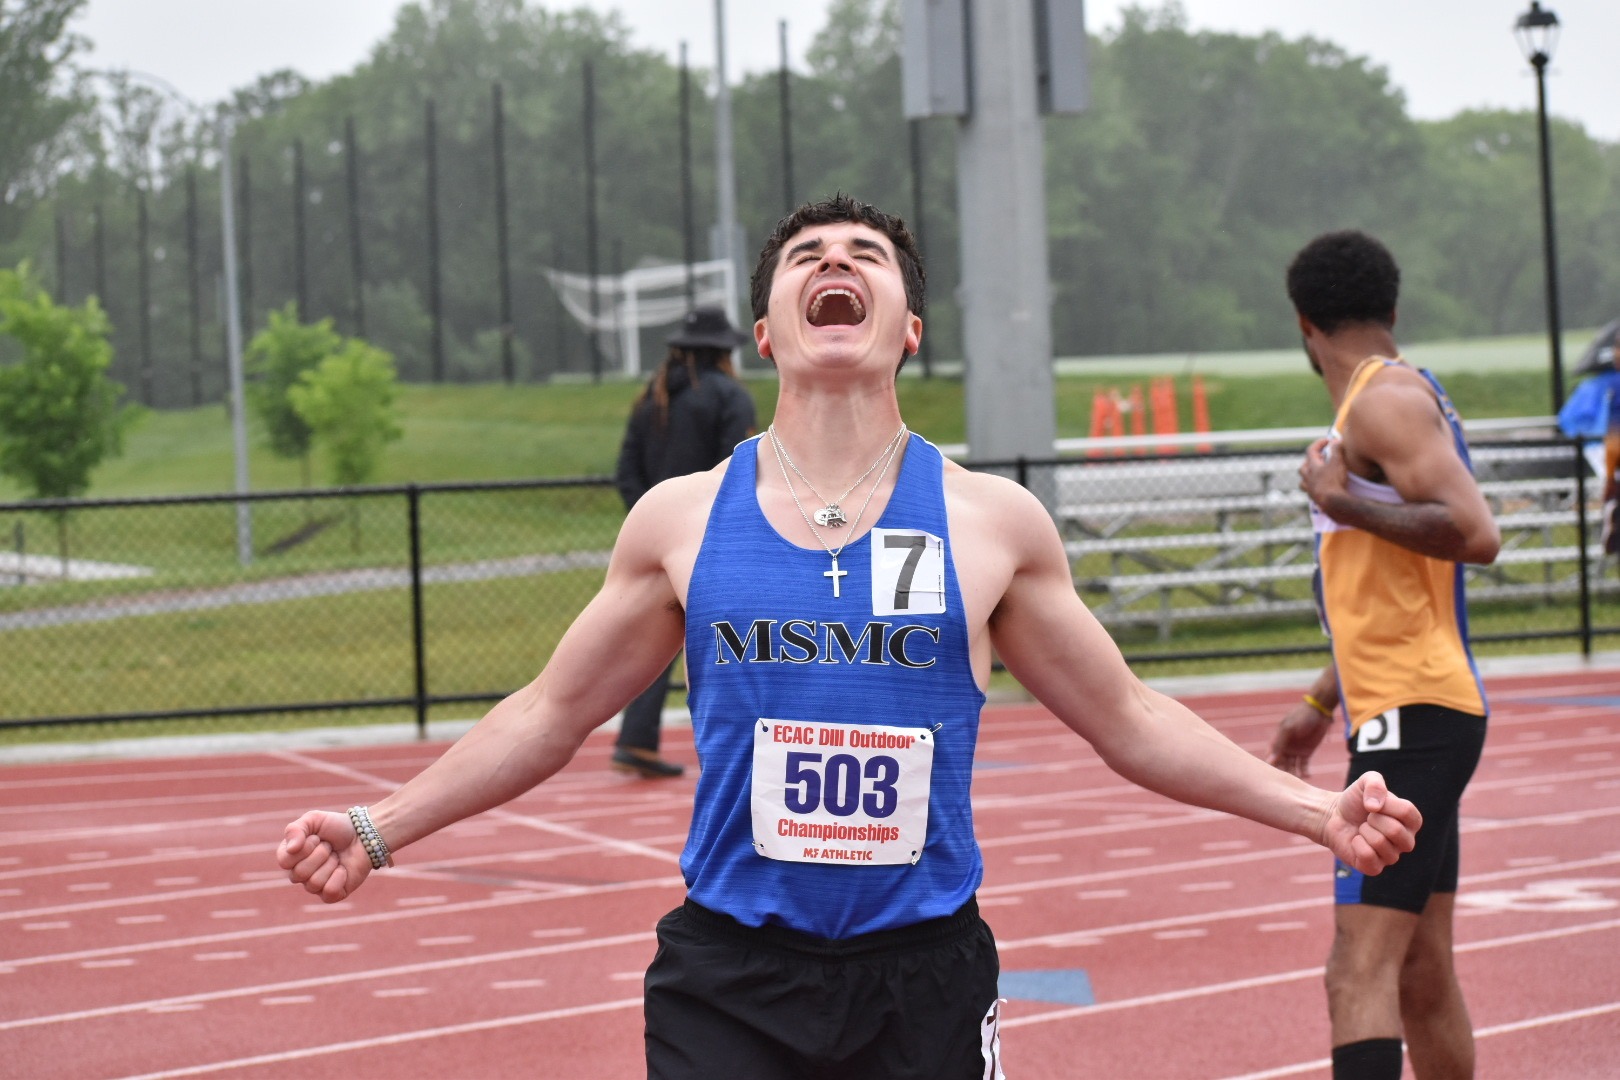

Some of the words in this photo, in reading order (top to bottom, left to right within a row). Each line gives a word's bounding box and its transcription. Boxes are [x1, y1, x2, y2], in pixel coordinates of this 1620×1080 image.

[883, 535, 926, 610] 7
[711, 619, 940, 668] MSMC
[773, 725, 814, 745] ECAC
[850, 730, 915, 749] Outdoor
[784, 751, 900, 818] 503
[777, 818, 900, 843] Championships
[821, 849, 873, 861] ATHLETIC
